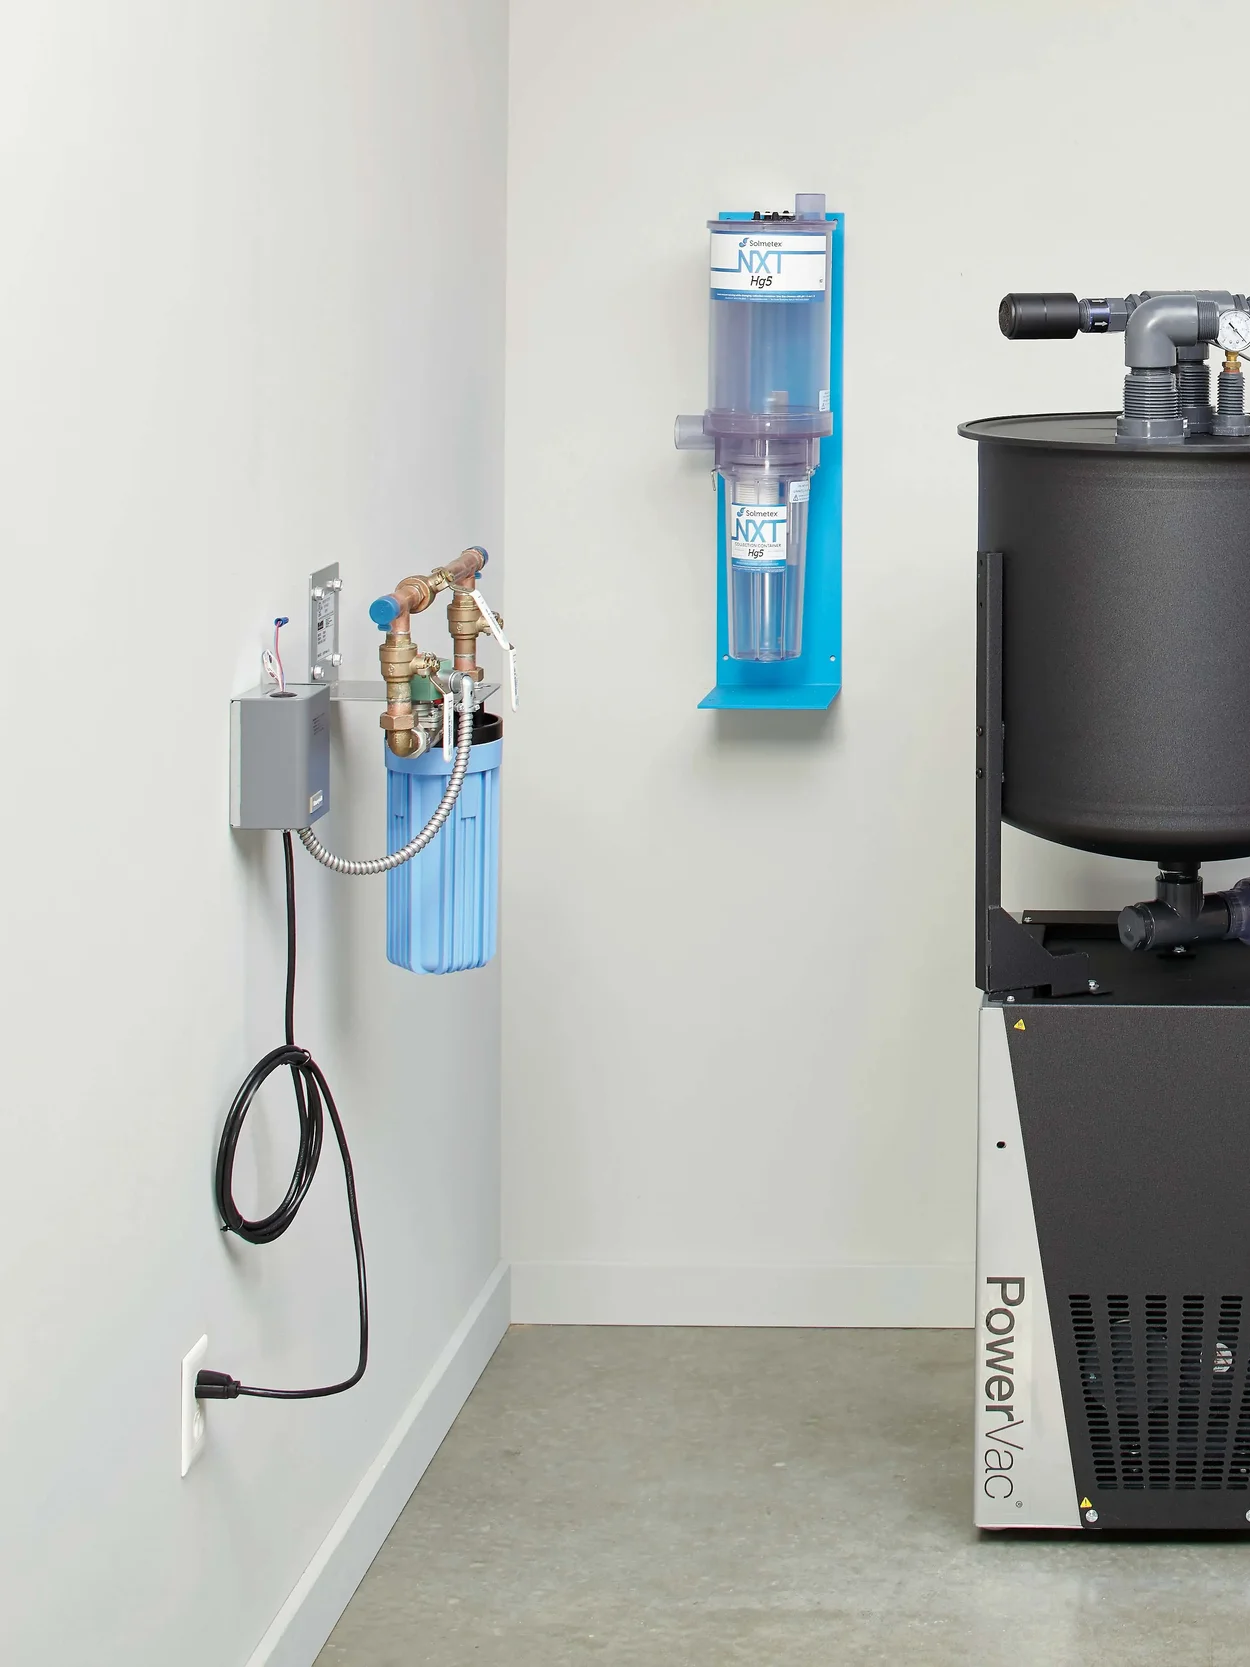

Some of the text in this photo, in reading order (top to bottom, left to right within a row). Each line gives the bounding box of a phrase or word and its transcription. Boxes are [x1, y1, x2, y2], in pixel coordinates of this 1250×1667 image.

[749, 239, 783, 248] Solmetex
[737, 249, 782, 274] NXT
[750, 275, 773, 290] Hg5
[745, 509, 778, 518] Solmetex
[735, 517, 786, 543] NXT
[747, 548, 764, 559] Hg5
